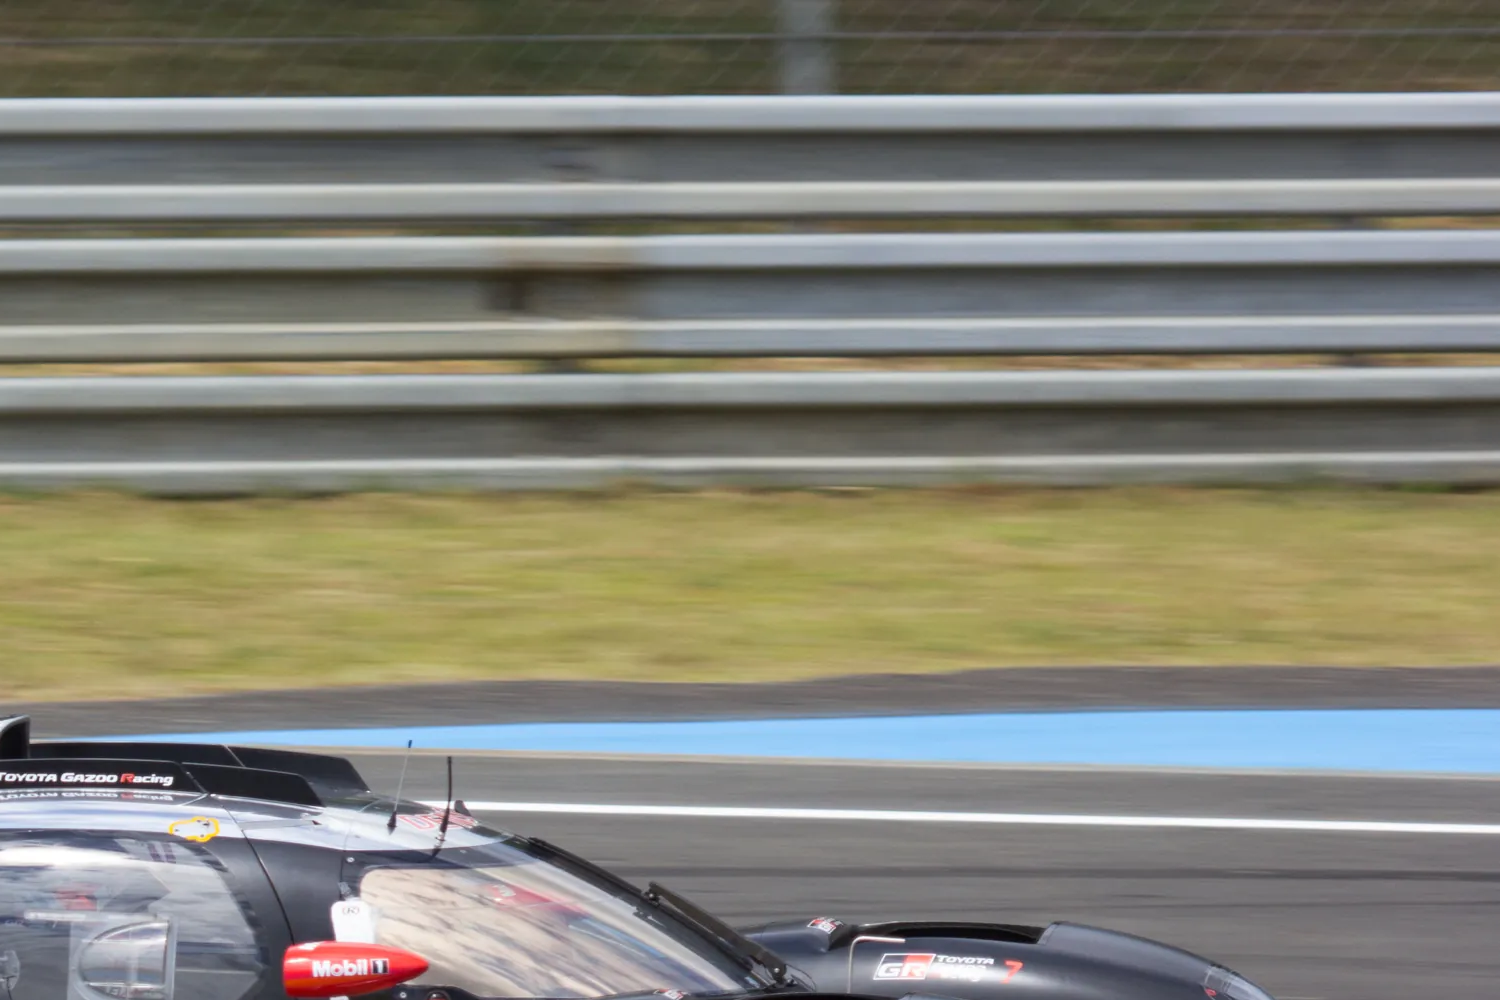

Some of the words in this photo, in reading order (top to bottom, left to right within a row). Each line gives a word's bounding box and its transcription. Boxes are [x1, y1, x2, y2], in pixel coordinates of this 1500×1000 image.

[60, 772, 118, 784] GAZOO
[120, 773, 173, 786] Racing
[312, 959, 368, 977] Mobil
[937, 955, 995, 965] TOYOTA
[877, 962, 926, 978] GR
[1002, 960, 1024, 984] 7
